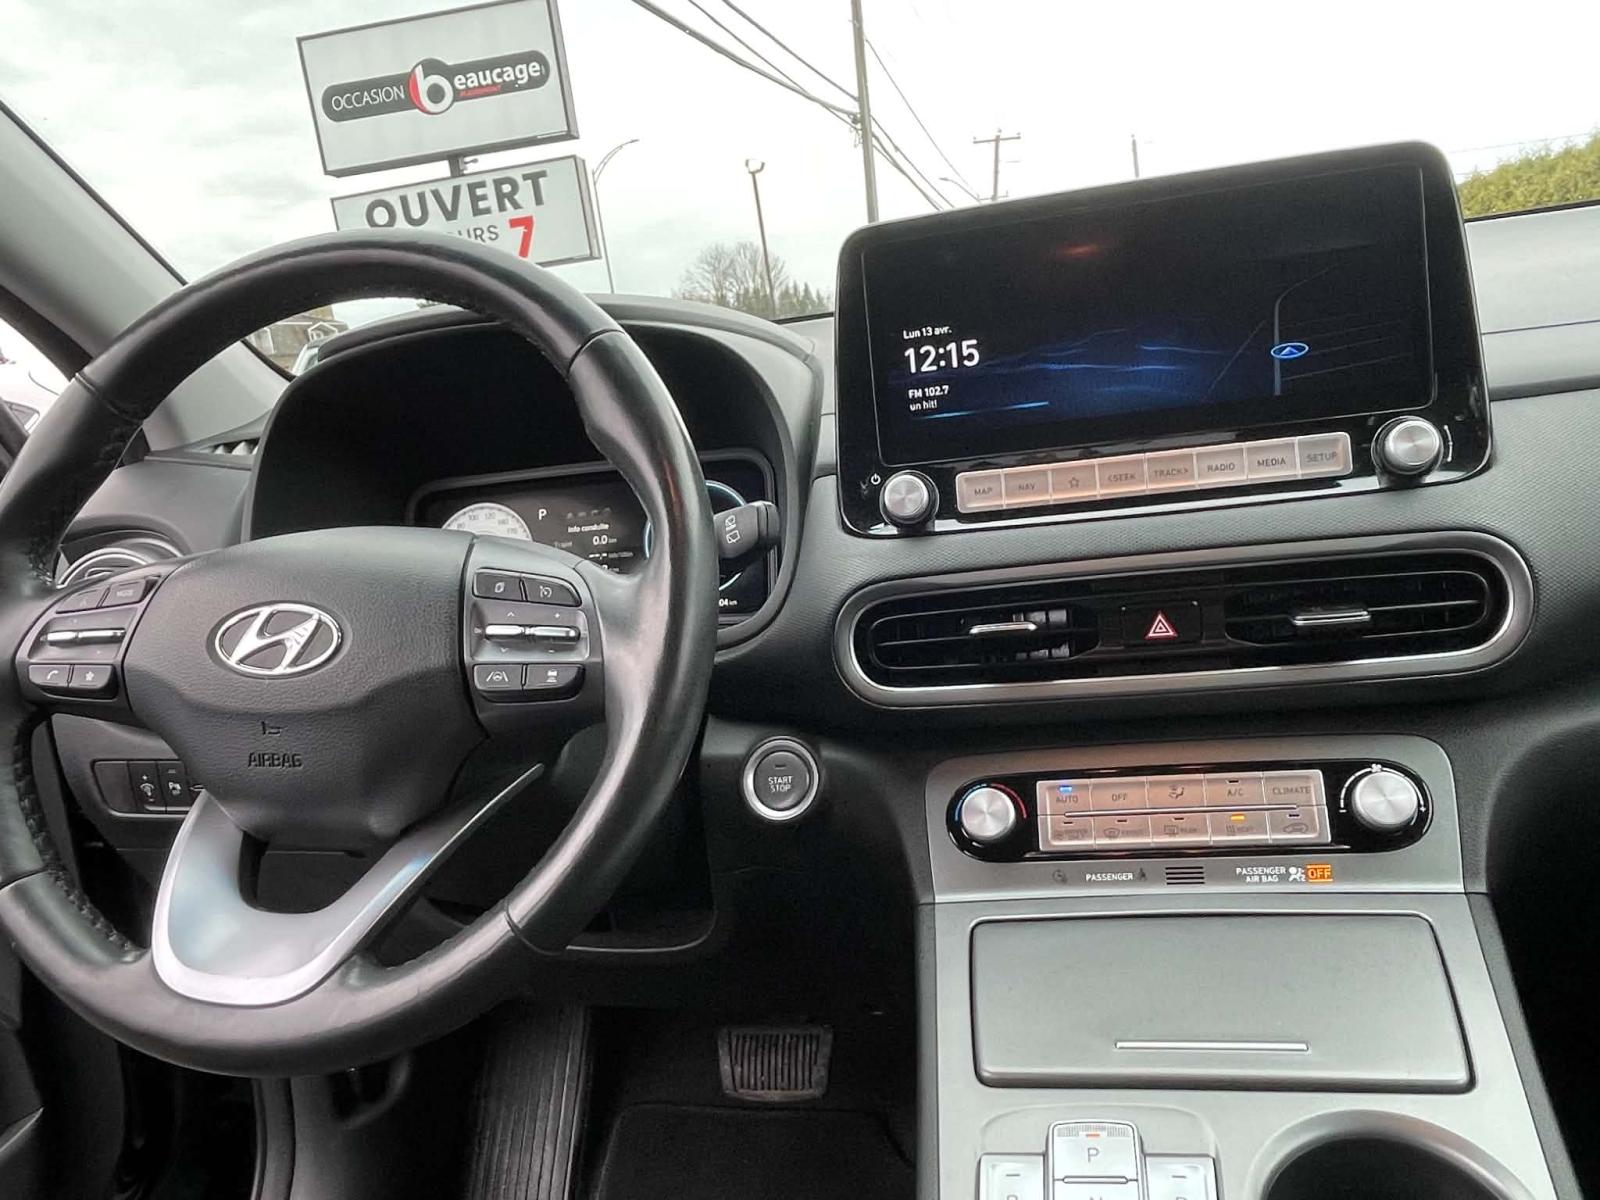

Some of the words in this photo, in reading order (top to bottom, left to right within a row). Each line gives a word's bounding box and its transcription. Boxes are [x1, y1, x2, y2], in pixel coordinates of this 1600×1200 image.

[332, 86, 405, 111] OCCASION
[366, 170, 547, 227] OUVERT
[508, 215, 534, 258] 7
[903, 329, 920, 339] Lun
[921, 327, 933, 337] 13
[934, 326, 952, 335] avr.
[904, 339, 980, 373] 12:15
[908, 389, 922, 399] FM
[924, 385, 949, 397] 102.7
[910, 402, 922, 411] un
[974, 487, 993, 496] MAP
[1018, 482, 1036, 492] NAV
[1207, 461, 1236, 473] RADIO
[1256, 456, 1287, 468] MEDIA
[1306, 451, 1338, 463] SETUP
[538, 508, 547, 520] P
[592, 535, 608, 545] 0.0
[248, 752, 303, 768] AIRBAG
[768, 776, 793, 785] START
[770, 784, 791, 792] STOP
[1227, 788, 1244, 797] A/C
[1272, 786, 1310, 795] CLIMATE
[1056, 794, 1079, 804] AUTO
[1085, 872, 1133, 881] PASSENGER
[1236, 867, 1286, 875] PASSENGER
[1307, 868, 1331, 879] OFF
[1246, 875, 1260, 883] AIR
[1261, 875, 1279, 883] BAG
[1087, 1147, 1100, 1162] P
